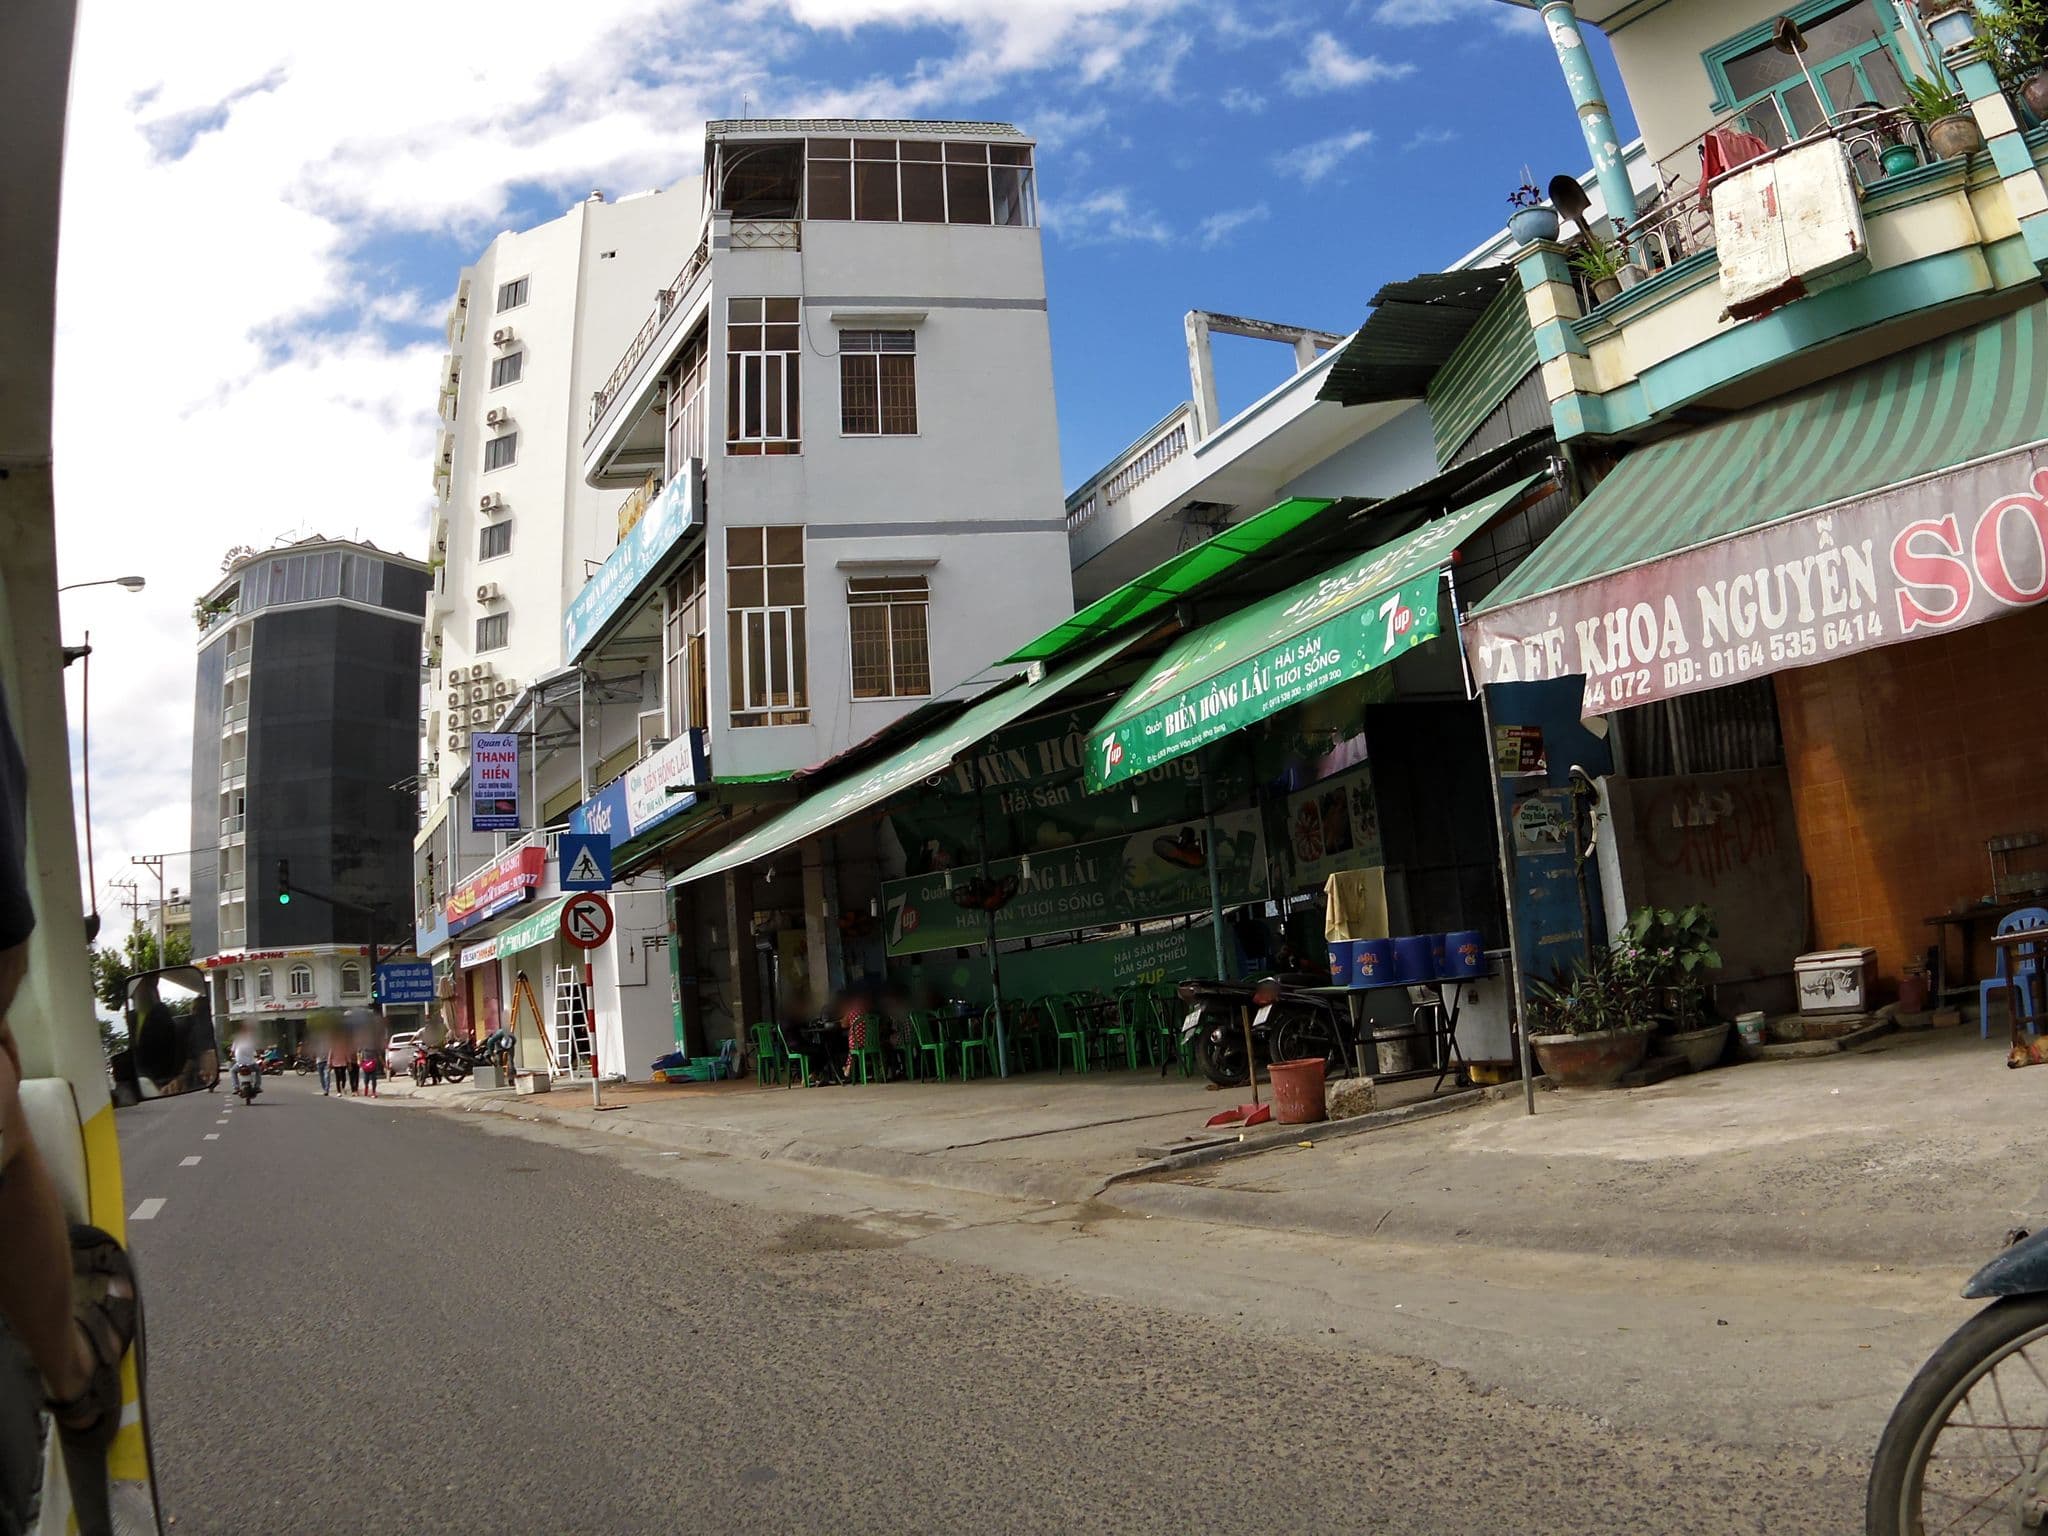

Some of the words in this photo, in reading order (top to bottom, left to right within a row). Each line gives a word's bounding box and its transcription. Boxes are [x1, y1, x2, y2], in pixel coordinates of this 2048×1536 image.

[1575, 594, 1690, 679] KHOA
[1696, 515, 1877, 648] NGUYỄN
[1274, 665, 1301, 689] TƯƠI
[1304, 649, 1341, 677] SỐNG
[1275, 647, 1295, 670] HẢI
[1298, 636, 1321, 660] SẢN
[1610, 669, 1651, 701] 072
[1663, 658, 1702, 688] DĐ:
[1709, 640, 1764, 678] 0164
[1770, 627, 1816, 661] 535
[1823, 610, 1883, 650] 6414
[1145, 721, 1162, 736] Quán
[1165, 695, 1197, 737] BIỂN
[1200, 681, 1238, 722] HỒNG
[1241, 660, 1271, 702] LẦU
[475, 752, 515, 763] THANH
[477, 738, 501, 749] Quán
[502, 736, 514, 747] Ốc
[1038, 713, 1086, 775] HỒ
[1032, 782, 1071, 808] Sản
[1059, 848, 1099, 887] LẦU
[1018, 900, 1053, 919] TƯƠI
[1058, 891, 1105, 912] SỐNG
[1156, 932, 1185, 951] NGON
[1136, 957, 1156, 970] SAO
